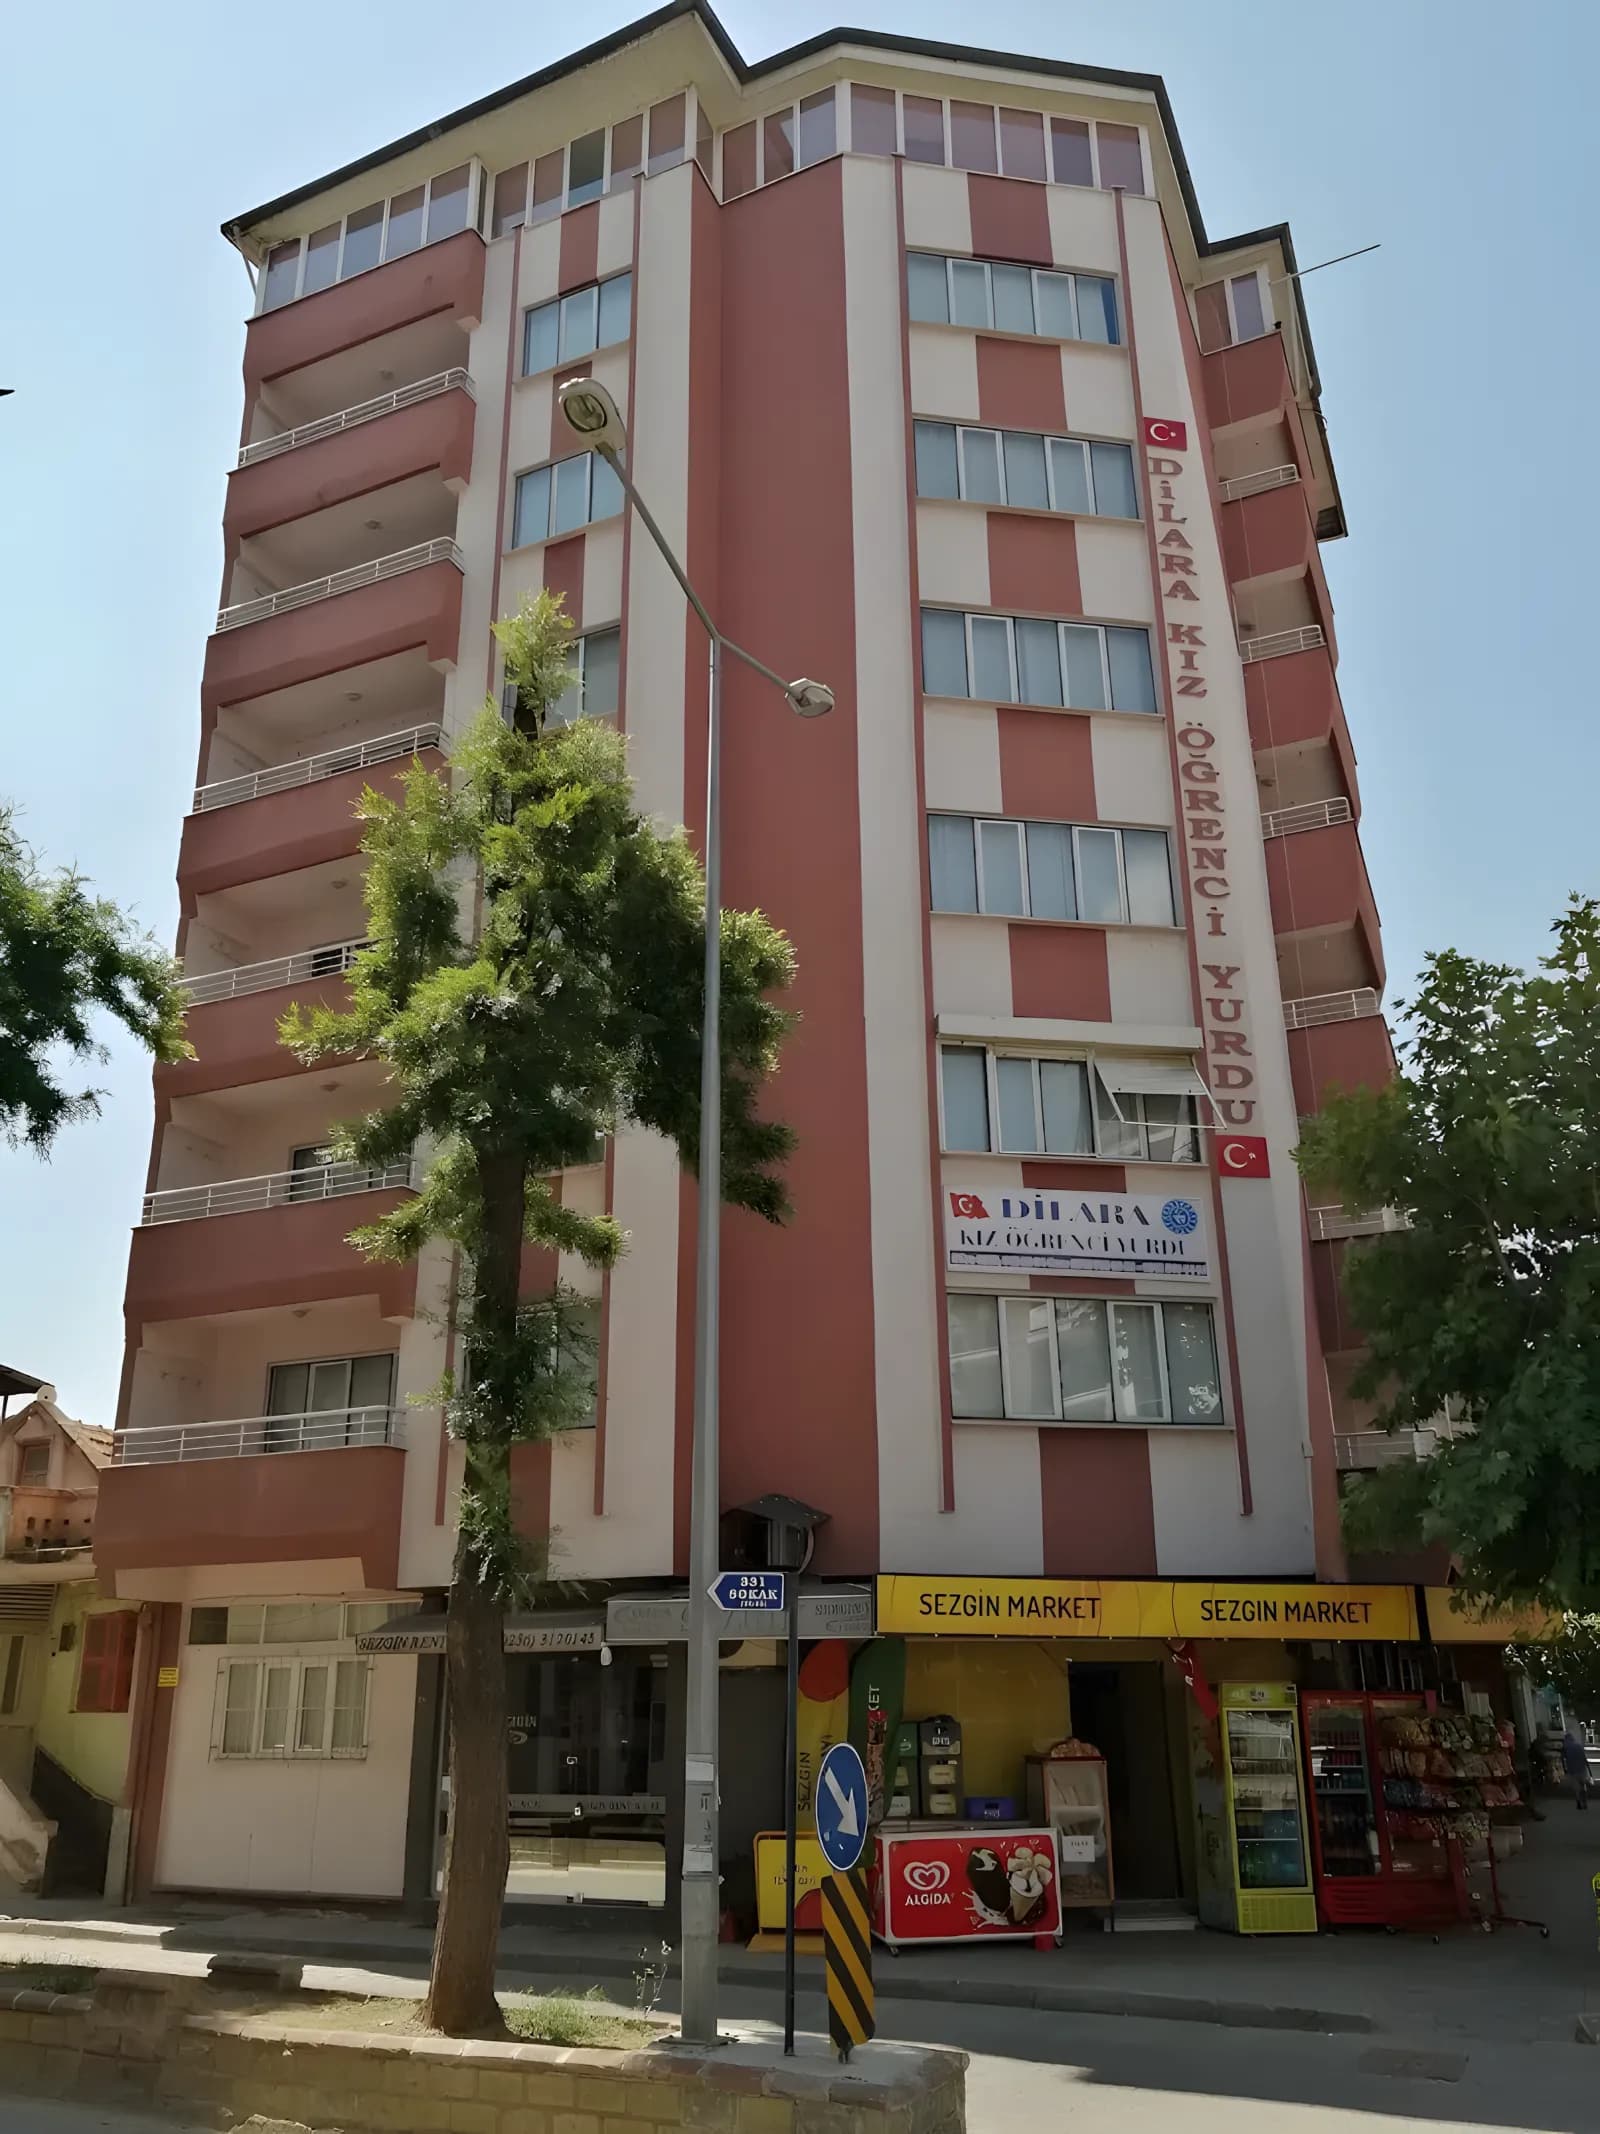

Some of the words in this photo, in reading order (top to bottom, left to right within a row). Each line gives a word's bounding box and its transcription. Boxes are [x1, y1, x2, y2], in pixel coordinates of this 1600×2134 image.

[1167, 623, 1208, 699] KIZ
[1177, 721, 1231, 937] ÖĞRENCİ
[1202, 964, 1257, 1125] YURDU
[728, 1588, 778, 1600] SOKAK
[919, 1588, 1000, 1617] SEZGİN
[1008, 1595, 1101, 1619] MARKET
[1284, 1601, 1373, 1624] MARKET
[904, 1892, 952, 1907] ALGIDA
